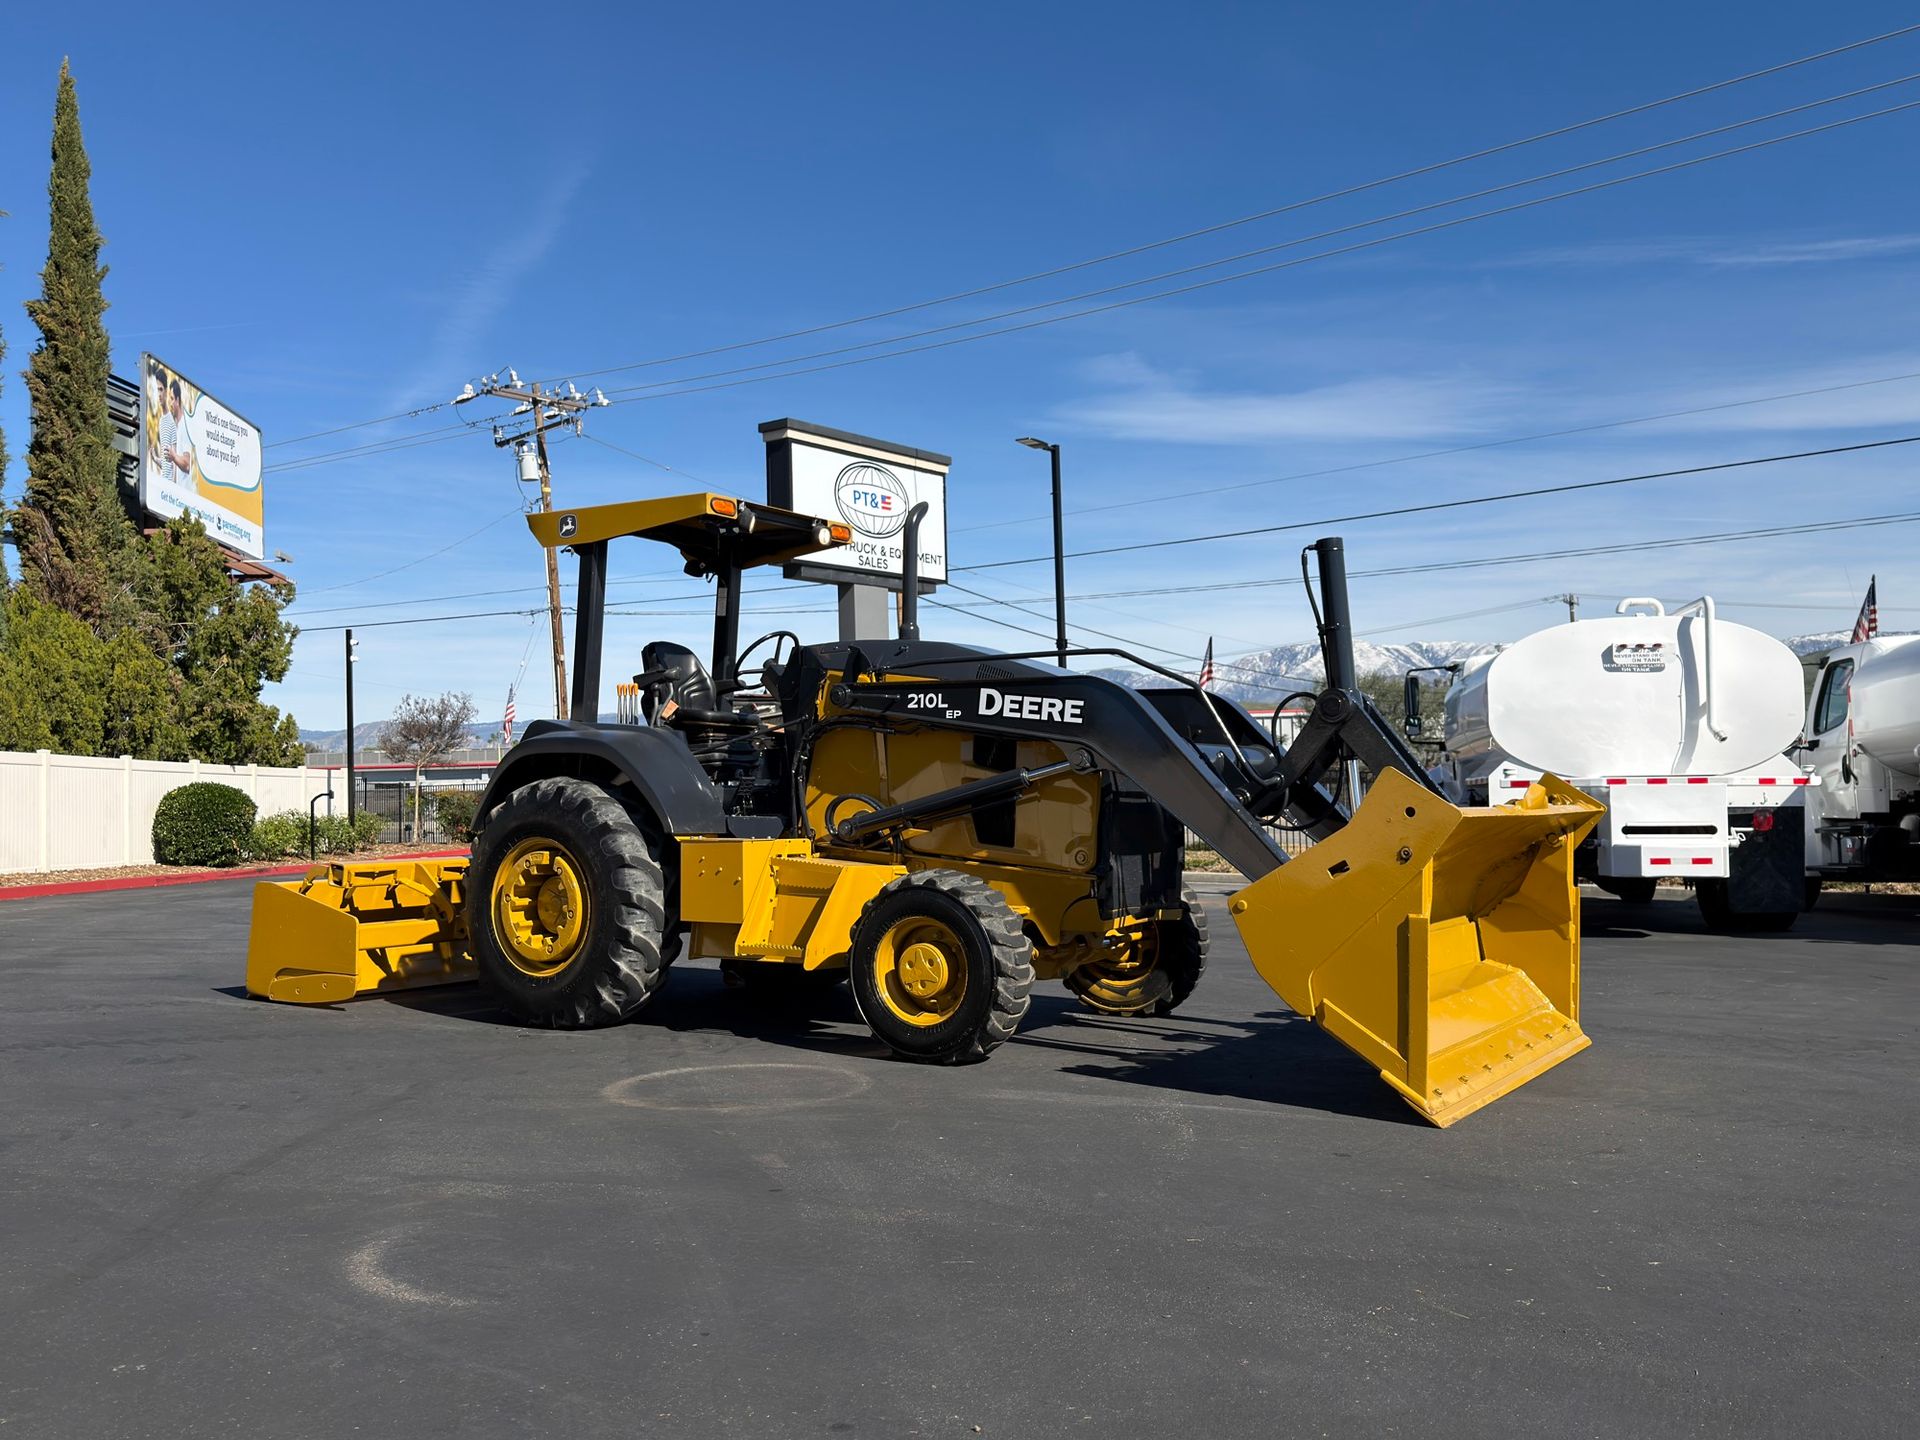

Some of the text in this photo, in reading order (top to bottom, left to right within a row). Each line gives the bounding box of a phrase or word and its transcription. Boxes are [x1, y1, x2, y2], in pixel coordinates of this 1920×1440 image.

[205, 410, 220, 426] What's
[229, 420, 240, 437] thing
[206, 430, 235, 450] would change
[206, 444, 219, 459] about
[220, 450, 229, 462] your
[222, 519, 251, 542] parenting.org
[858, 555, 888, 570] SALES
[880, 545, 887, 557] &
[889, 547, 943, 565] EQMENT
[907, 693, 962, 719] 210L EP
[978, 687, 1085, 724] DEERE
